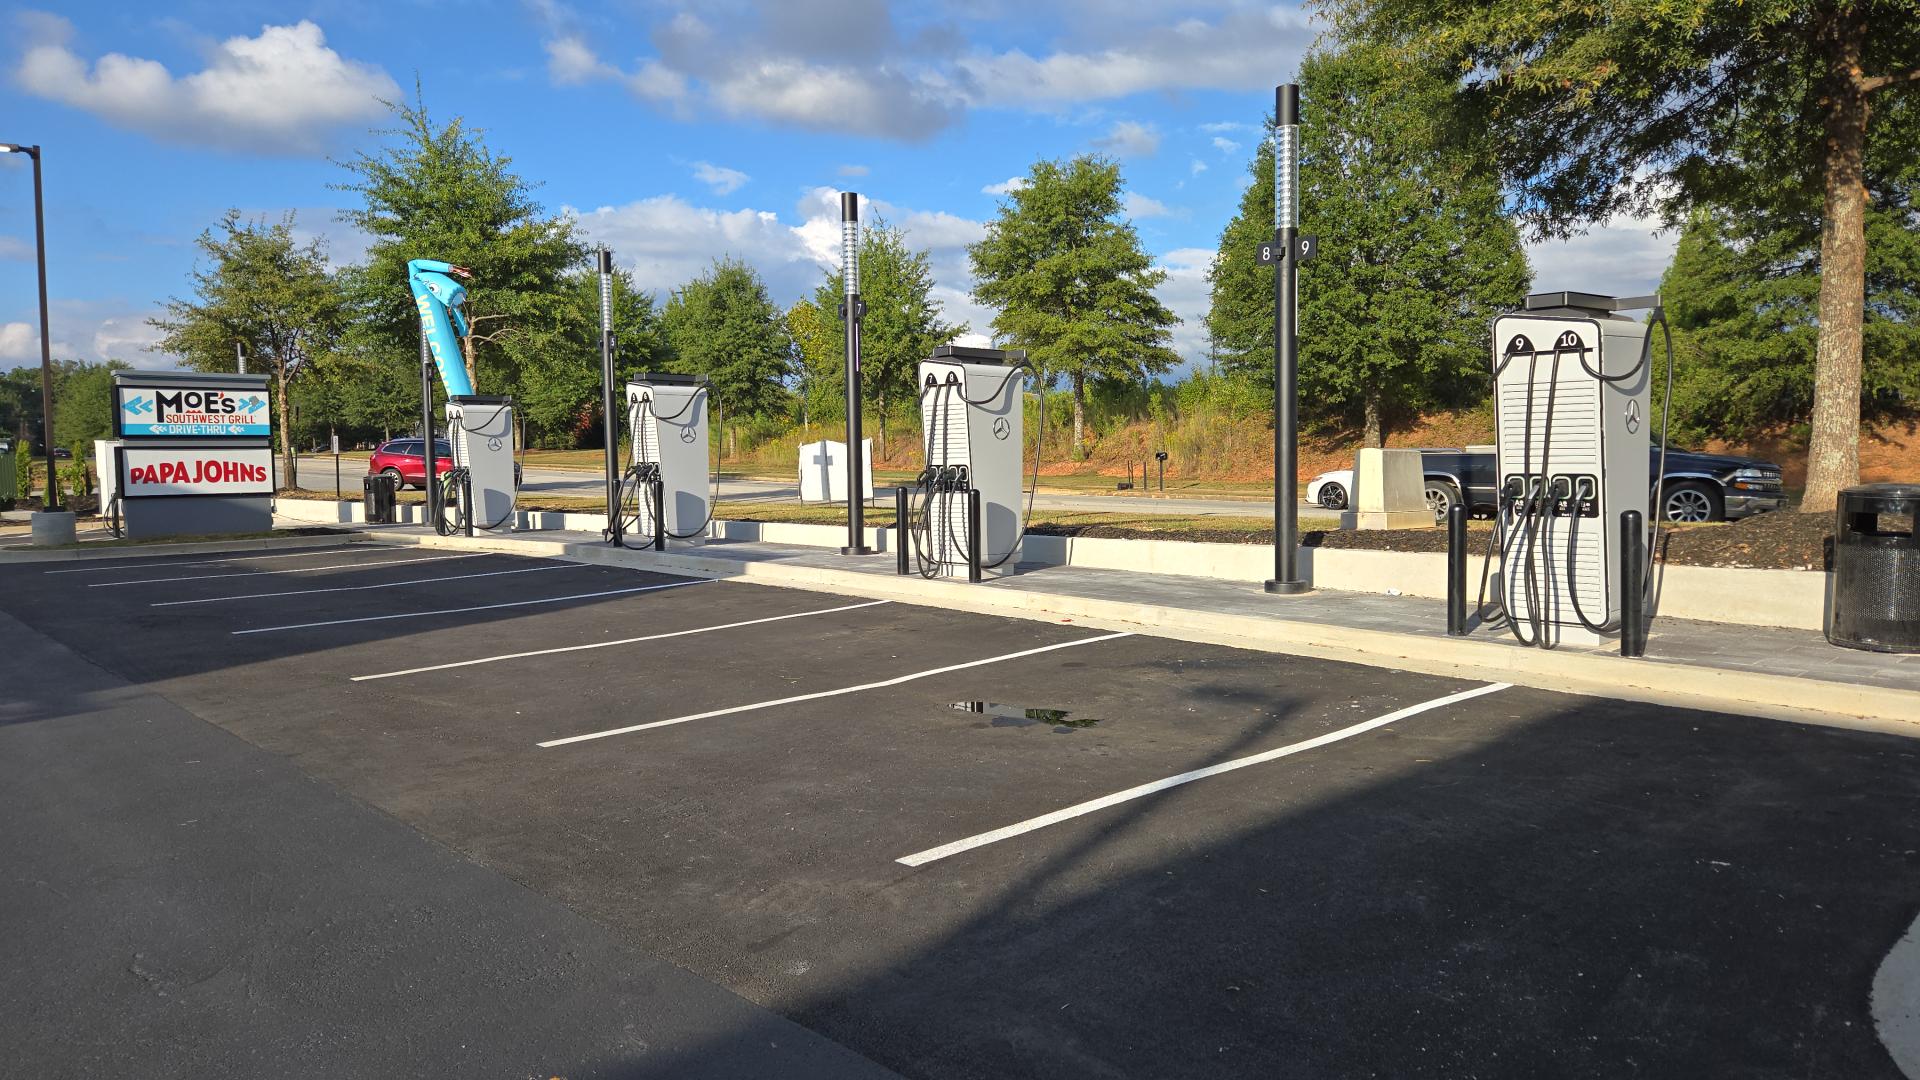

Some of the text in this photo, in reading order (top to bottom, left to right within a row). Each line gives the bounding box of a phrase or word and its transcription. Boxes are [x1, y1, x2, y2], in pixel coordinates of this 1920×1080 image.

[1263, 246, 1270, 260] 8
[1301, 240, 1309, 255] 9
[857, 303, 862, 315] 7
[1515, 334, 1577, 350] 9 10
[165, 414, 226, 424] SOUTHWEST
